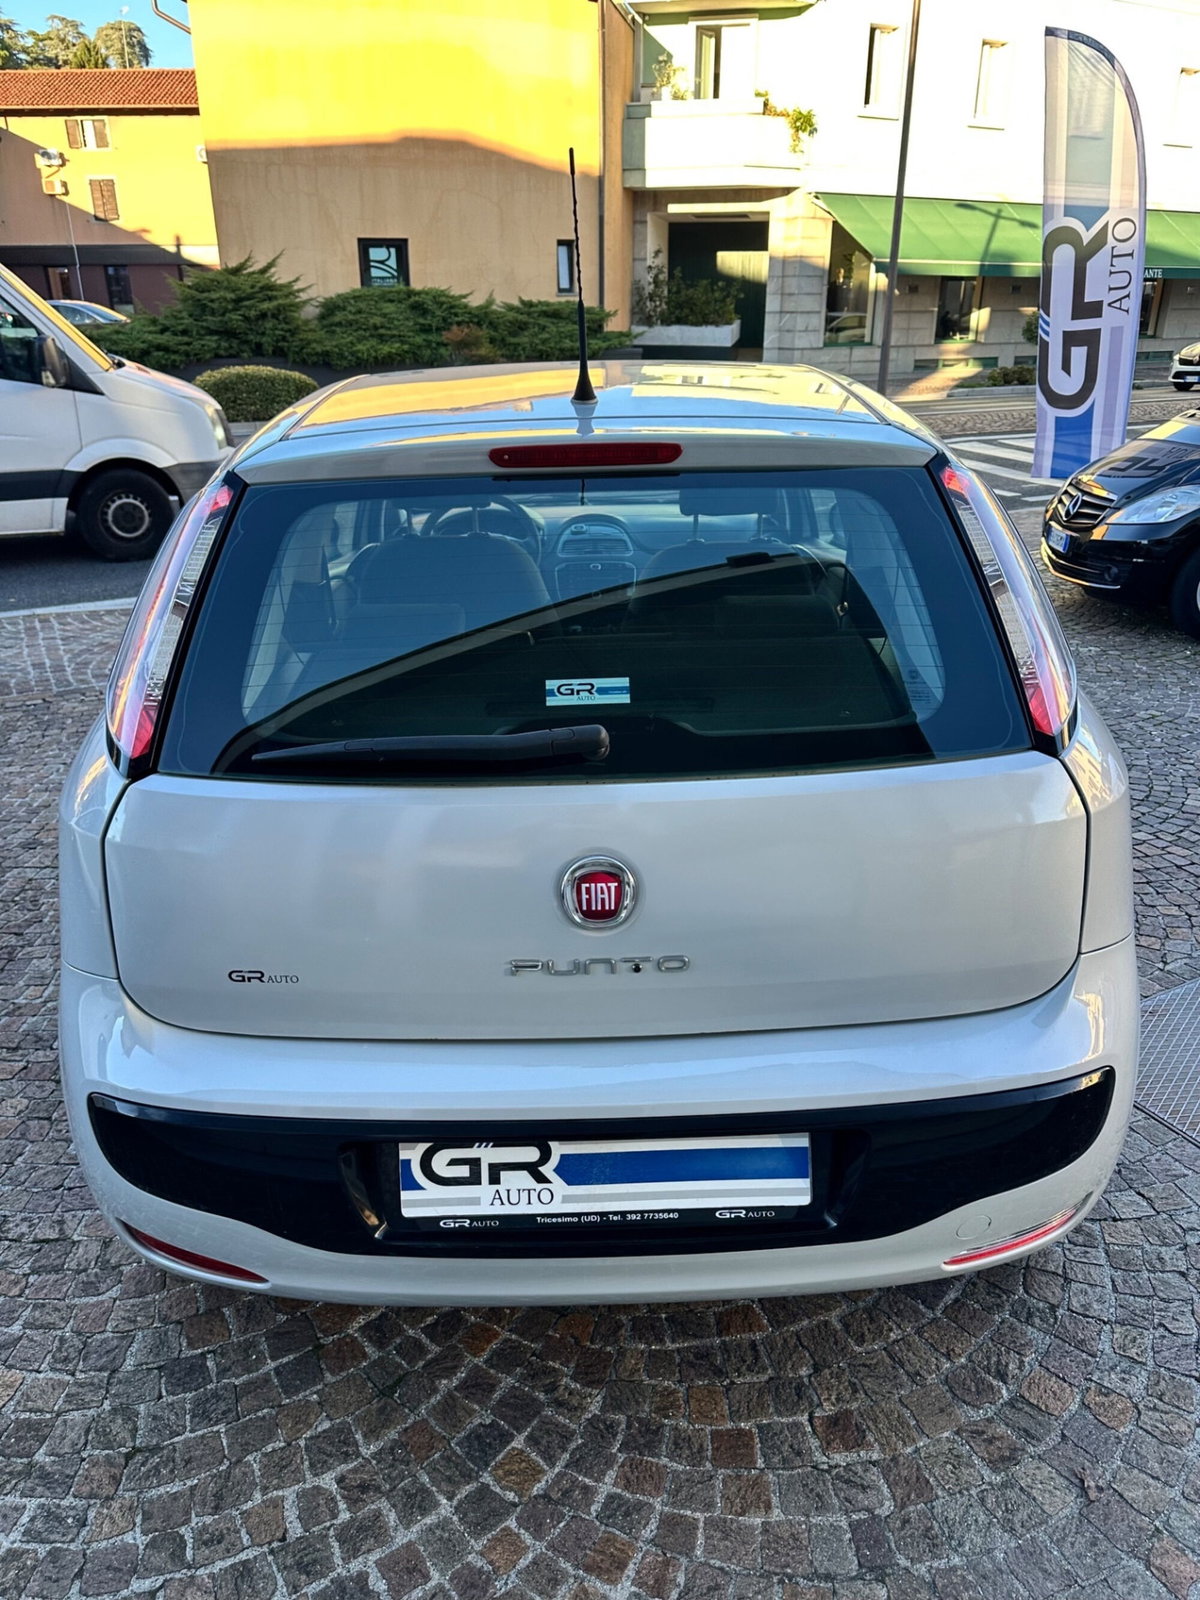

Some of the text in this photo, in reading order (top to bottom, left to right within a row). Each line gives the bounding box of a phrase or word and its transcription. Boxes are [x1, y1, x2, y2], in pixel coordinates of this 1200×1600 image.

[1107, 217, 1137, 314] AUTO
[1037, 221, 1109, 410] GR
[556, 683, 596, 696] GR
[581, 882, 618, 911] FIAT
[509, 955, 690, 976] PUNTO
[228, 969, 300, 984] GR AUTO
[419, 1141, 554, 1187] GR
[489, 1187, 555, 1207] AUTO
[439, 1218, 470, 1228] GR
[536, 1216, 579, 1224] Tricesimo
[581, 1214, 601, 1223] (UD)
[626, 1213, 642, 1221] 392
[643, 1212, 679, 1220] 7735640
[715, 1209, 776, 1219] GR AUTO
